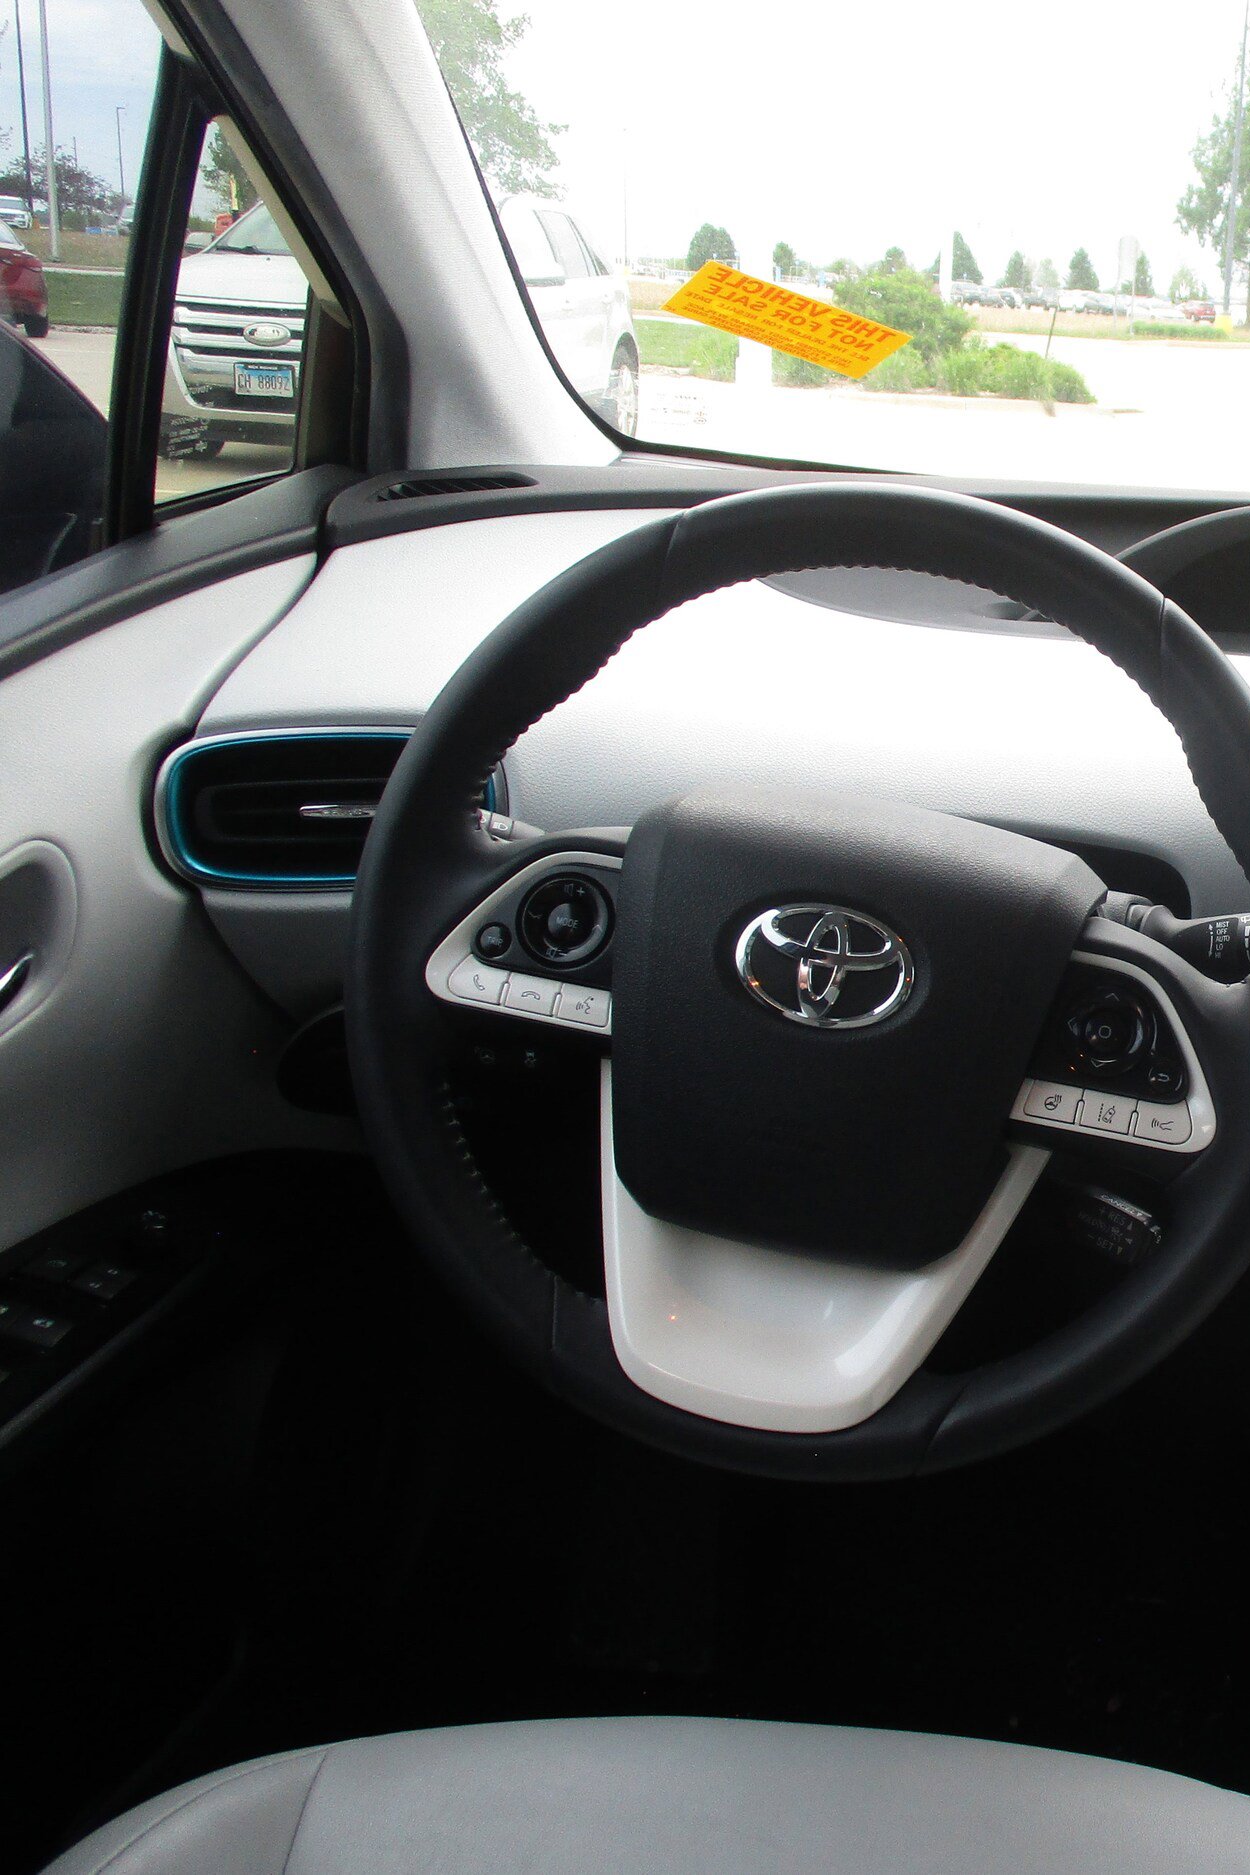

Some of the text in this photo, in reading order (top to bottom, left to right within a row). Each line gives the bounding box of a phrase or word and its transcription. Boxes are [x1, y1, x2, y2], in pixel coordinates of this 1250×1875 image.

[237, 373, 251, 389] CH
[556, 917, 579, 929] MODE
[1216, 928, 1228, 936] OFF
[1215, 935, 1230, 943] AUTO
